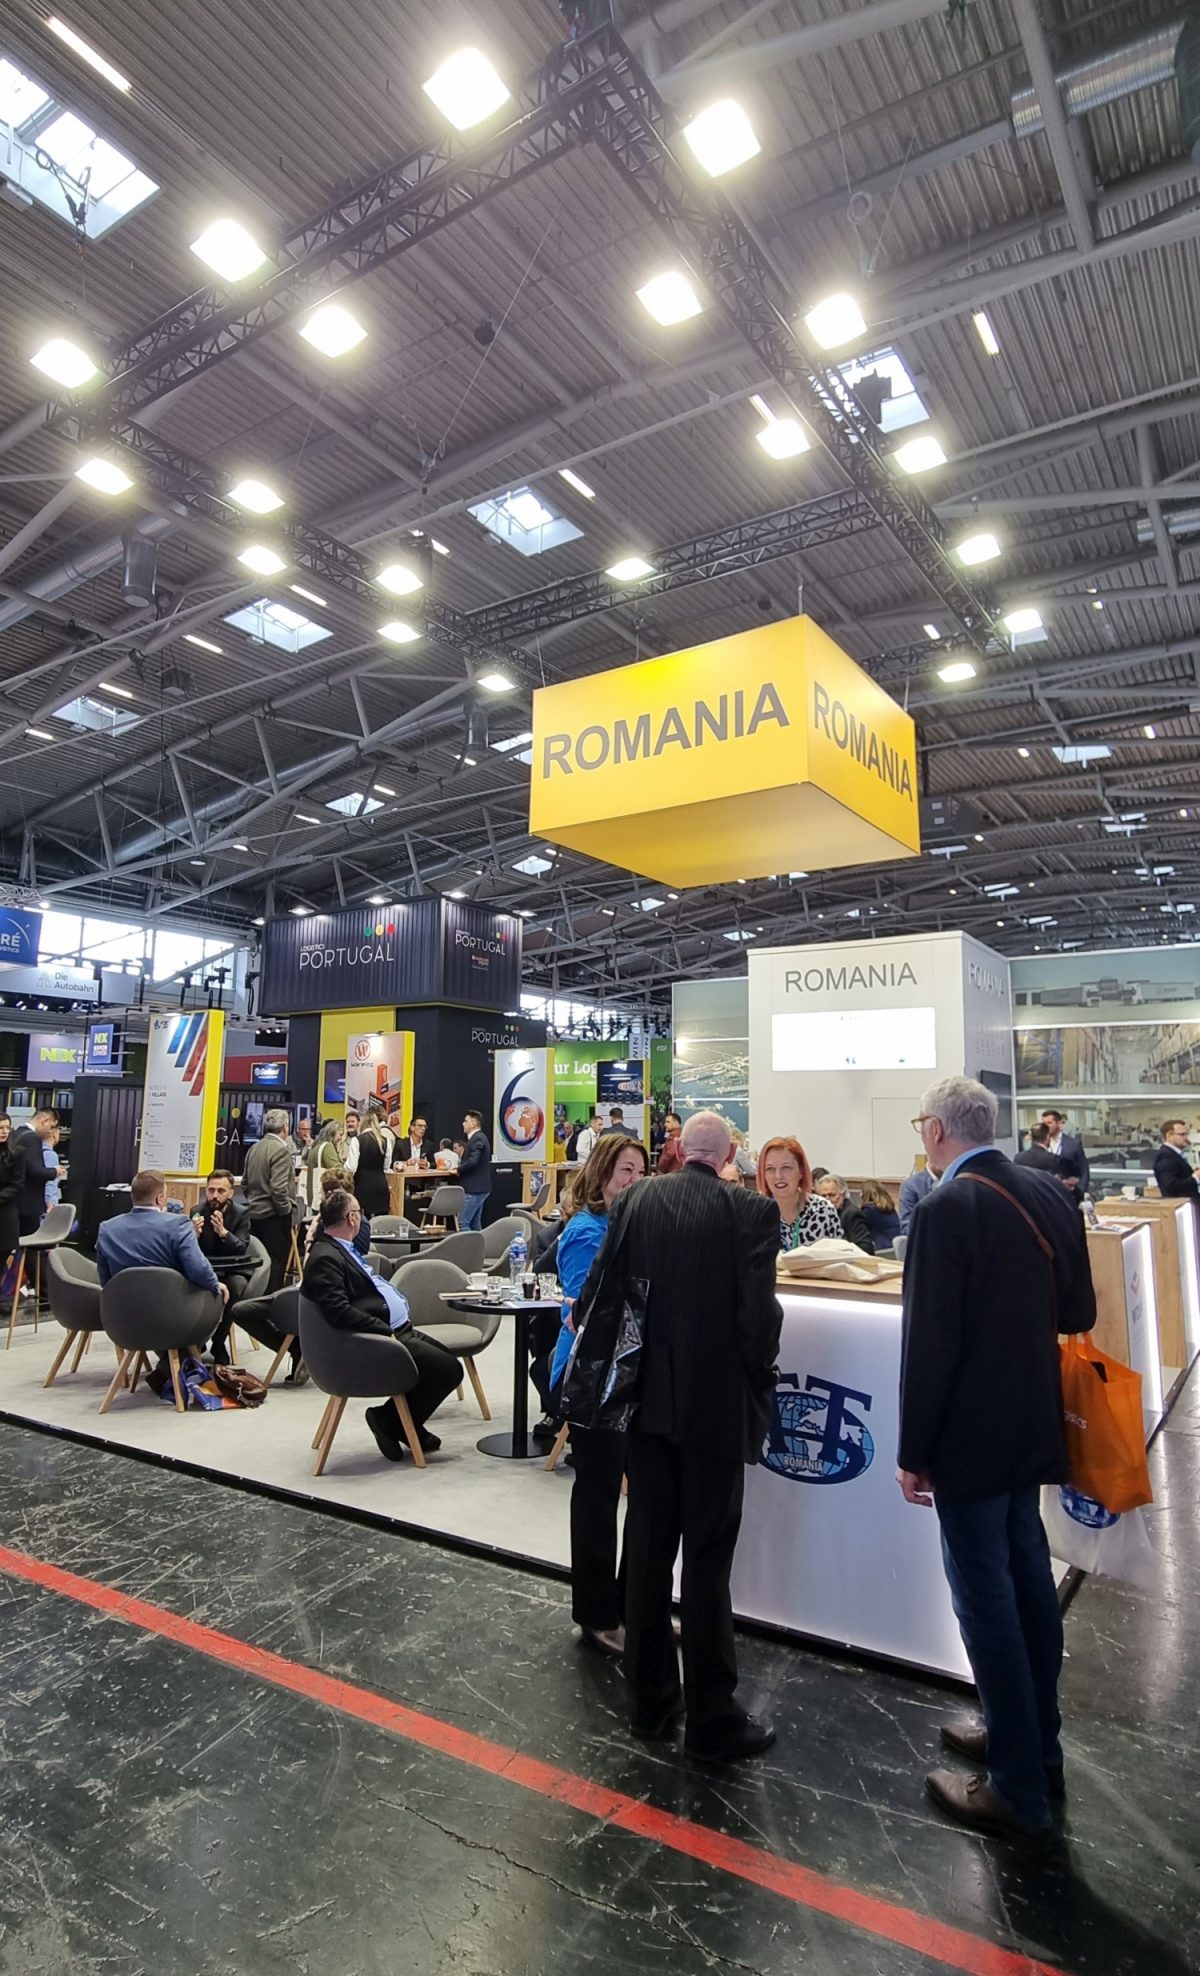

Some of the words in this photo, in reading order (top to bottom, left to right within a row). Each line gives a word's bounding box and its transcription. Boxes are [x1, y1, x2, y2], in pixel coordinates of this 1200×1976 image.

[542, 682, 790, 779] ROMANIA
[813, 680, 914, 802] ROMANIA
[455, 933, 506, 956] PORTUGAL
[299, 942, 395, 971] PORTUGAL
[54, 972, 69, 980] Die
[54, 981, 94, 993] Autobahn
[785, 962, 918, 993] ROMANIA
[471, 1030, 520, 1047] PORTUGAL
[784, 1455, 824, 1472] ROMANIA
